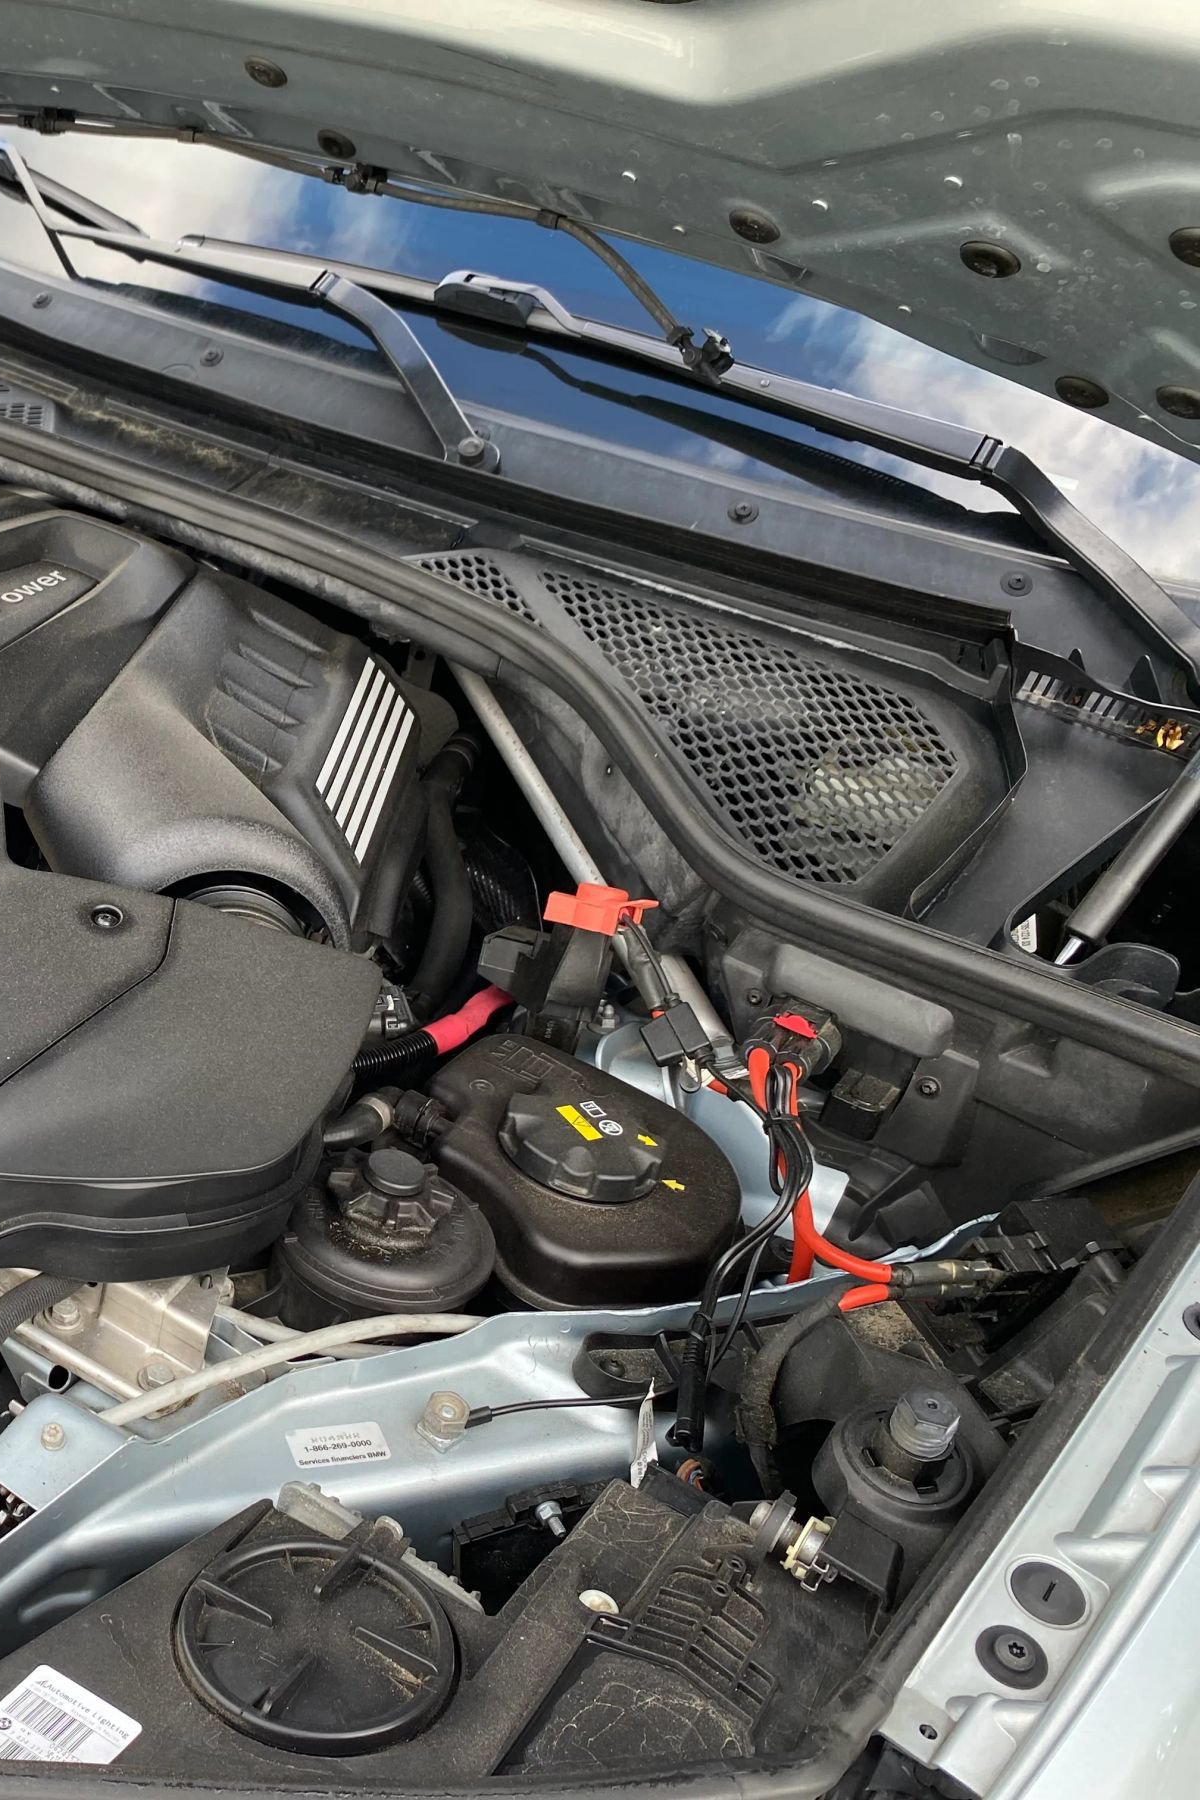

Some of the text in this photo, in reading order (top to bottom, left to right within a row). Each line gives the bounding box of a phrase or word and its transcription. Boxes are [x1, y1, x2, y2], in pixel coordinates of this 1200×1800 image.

[304, 1439, 372, 1453] 1-866-269-0000
[299, 1450, 386, 1466] Services financiers BMW
[46, 1683, 91, 1714] Automotive
[92, 1712, 130, 1740] Lighting
